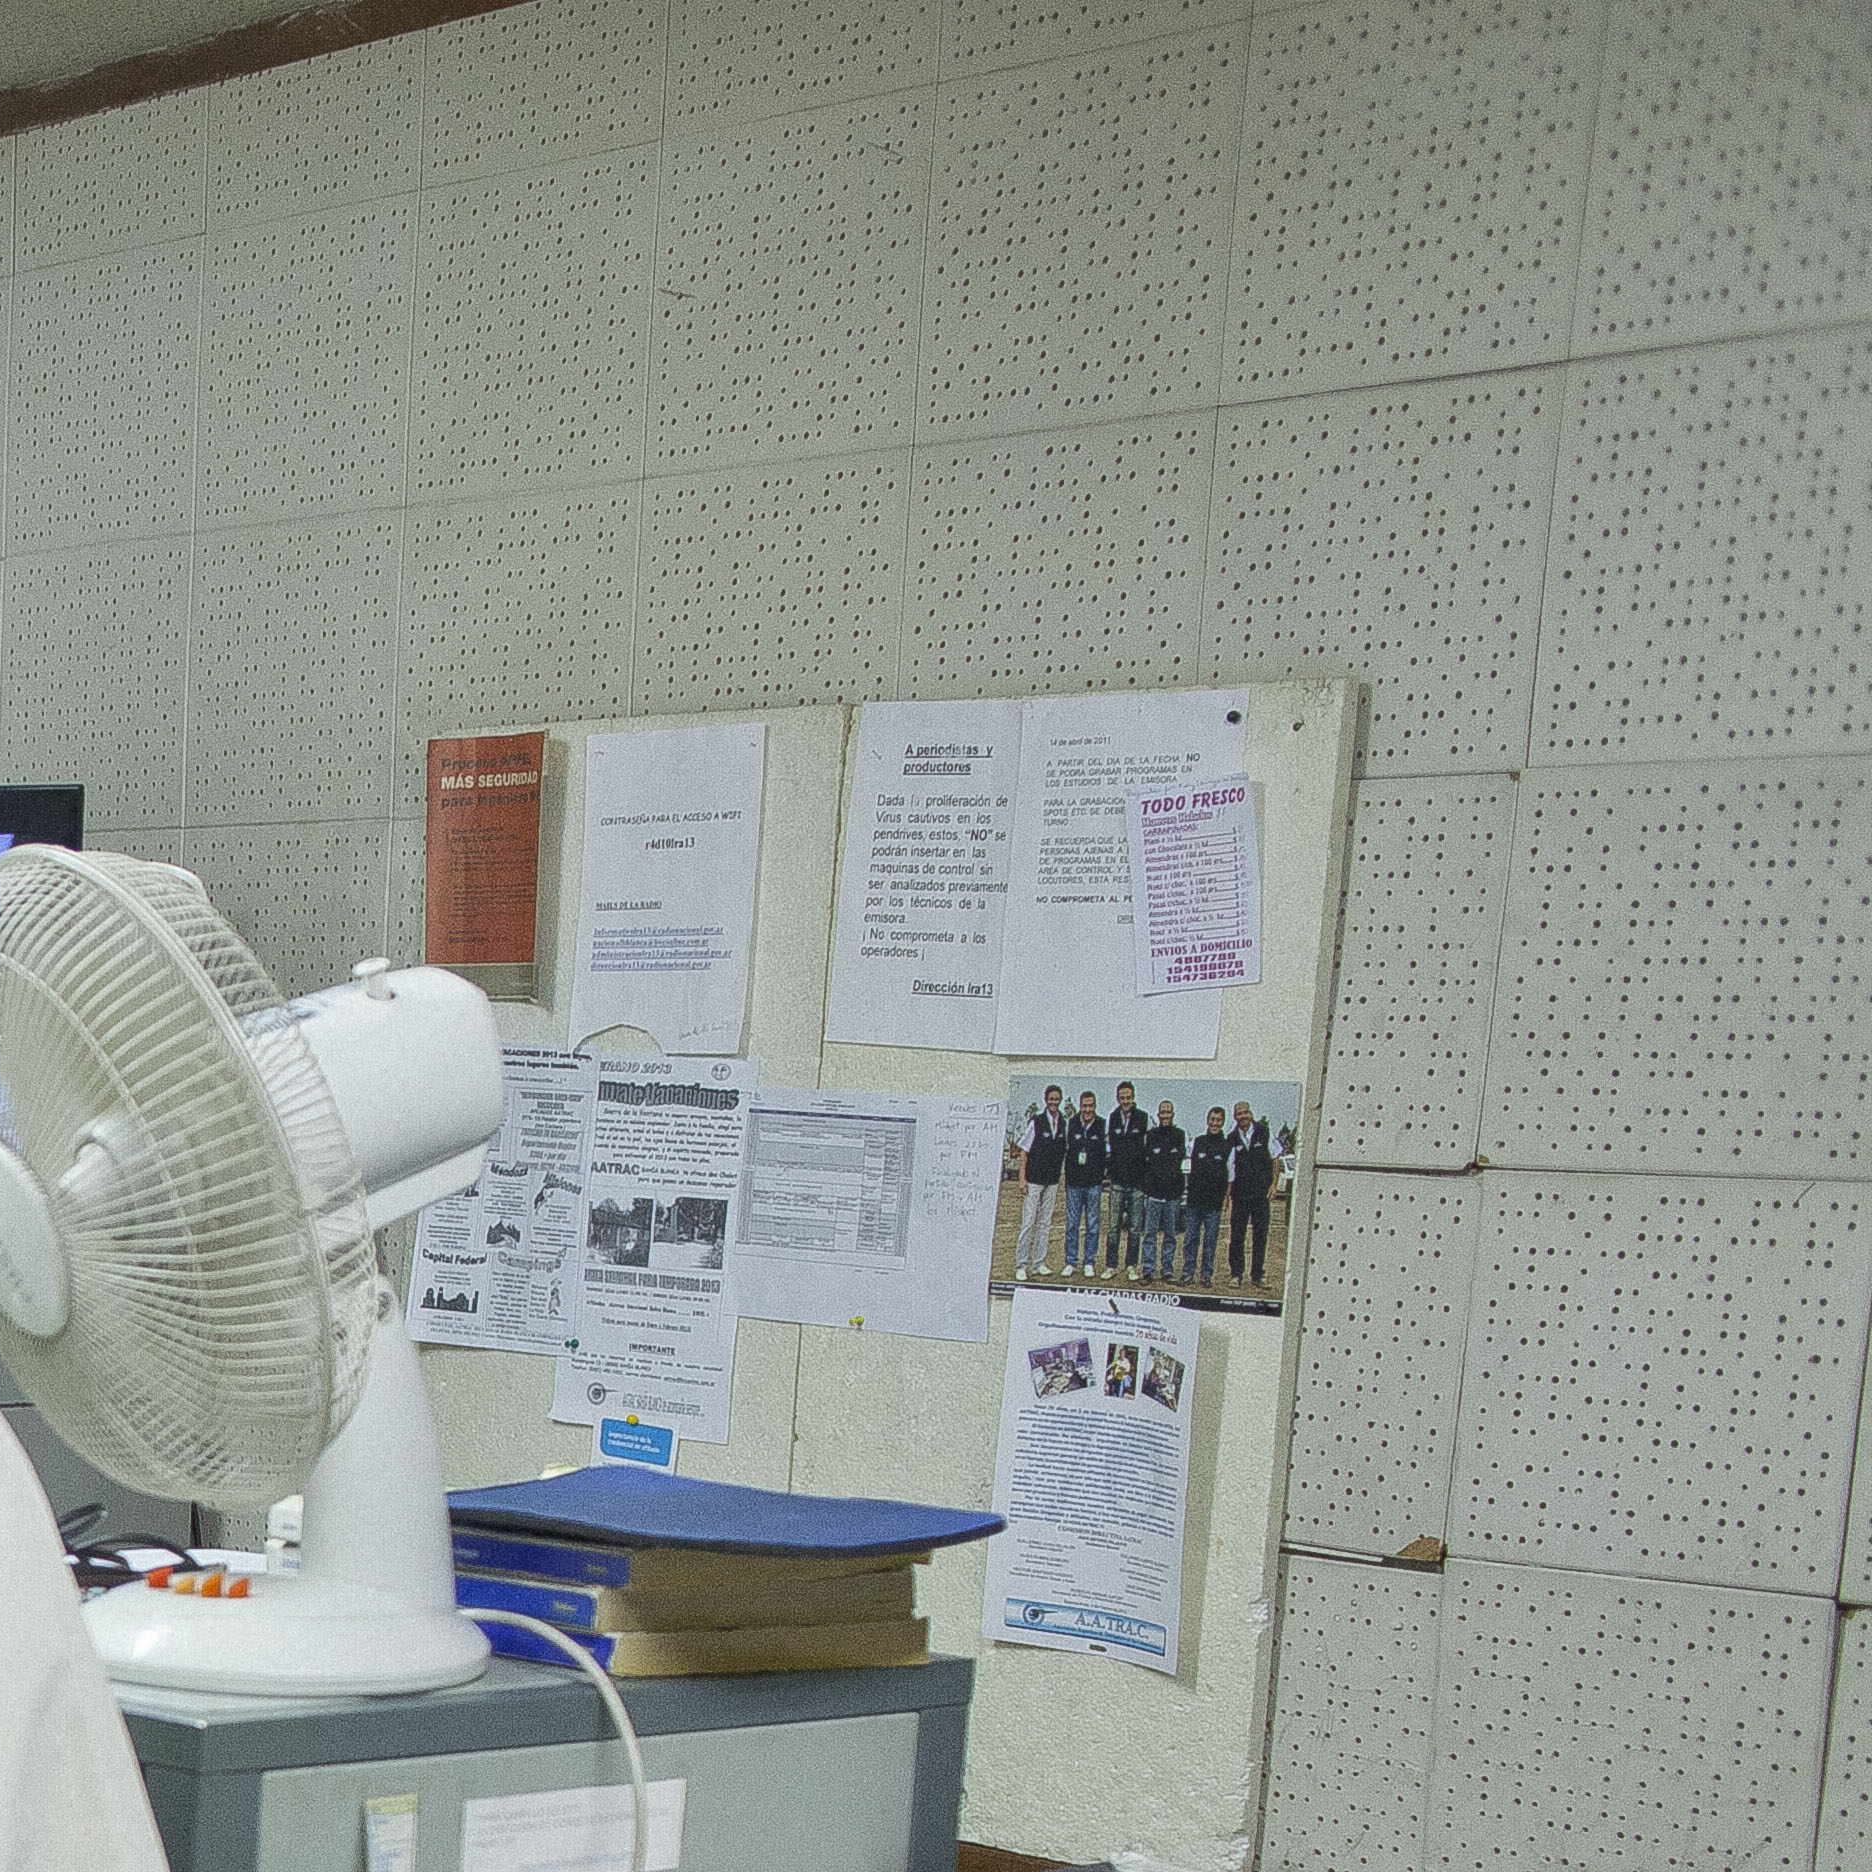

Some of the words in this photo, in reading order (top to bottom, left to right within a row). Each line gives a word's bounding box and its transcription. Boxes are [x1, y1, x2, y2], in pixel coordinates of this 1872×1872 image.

[1068, 737, 1082, 746] abril
[1084, 738, 1092, 746] de
[1094, 736, 1111, 745] 2011
[905, 744, 913, 756] A
[916, 744, 979, 757] periodistas
[986, 745, 993, 757] y
[1058, 759, 1084, 767] PARTIR
[1088, 758, 1103, 766] DEL
[1106, 757, 1120, 765] DIA
[1124, 757, 1135, 765] DE
[1140, 756, 1149, 764] LA
[1153, 755, 1180, 763] FECHA
[1186, 753, 1200, 761] NO
[903, 762, 971, 774] productores
[1089, 768, 1121, 776] GRABAR
[1126, 766, 1177, 775] PROGRAMAS
[1182, 765, 1192, 773] EN
[440, 773, 474, 789] MÁS
[478, 771, 538, 788] SEGURIDAD
[1045, 779, 1060, 788] LOS
[1064, 777, 1101, 787] ESTUDIOS
[1108, 777, 1118, 785] DE
[1124, 776, 1134, 784] LA
[1141, 775, 1177, 784] EMISORA
[877, 795, 905, 807] Dada
[925, 794, 991, 809] proliferación
[996, 795, 1008, 807] de
[1043, 799, 1064, 807] PARA
[1067, 798, 1077, 806] LA
[1141, 796, 1186, 815] TODO
[1192, 787, 1245, 808] FRESCO
[601, 813, 650, 826] CONTRASEÑA
[651, 814, 671, 824] PARA
[672, 814, 680, 822] EL
[683, 812, 712, 822] ACCESO
[714, 813, 720, 821] A
[721, 811, 742, 820] WIFI
[876, 811, 902, 823] Virus
[908, 812, 950, 824] cautivos
[957, 814, 970, 824] en
[976, 812, 991, 824] los
[1043, 808, 1067, 816] SPOTS
[873, 829, 926, 842] pendrives,
[995, 831, 1006, 841] se
[1041, 838, 1052, 846] SE
[1055, 837, 1096, 845] RECUERDA
[1097, 836, 1114, 844] QUE
[871, 845, 907, 859] podrán
[911, 846, 950, 857] insertar
[953, 848, 965, 858] en
[972, 847, 986, 858] las
[1040, 848, 1080, 856] PERSONAS
[1084, 847, 1114, 855] AJENAS
[1039, 857, 1050, 865] DE
[1053, 857, 1101, 865] PROGRAMAS
[1105, 856, 1116, 864] EN
[870, 863, 919, 876] maquinas
[923, 863, 935, 874] de
[939, 863, 975, 874] control
[980, 863, 993, 875] sin
[1062, 866, 1072, 874] DE
[1076, 865, 1113, 874] CONTROL
[1117, 865, 1124, 873] Y
[1089, 875, 1108, 884] ESTA
[868, 879, 885, 890] ser
[890, 880, 945, 891] analizados
[949, 881, 1008, 895] previamente
[620, 902, 628, 910] DE
[630, 901, 638, 909] LA
[640, 901, 662, 909] RADIO
[865, 896, 883, 909] por
[889, 896, 903, 907] los
[910, 897, 952, 909] técnicos
[959, 898, 972, 909] de
[978, 899, 986, 909] la
[1051, 895, 1105, 903] COMPROMETA
[1109, 895, 1120, 903] AL
[870, 928, 885, 940] No
[890, 930, 954, 944] comprometa
[961, 934, 967, 943] a
[973, 933, 986, 944] los
[861, 945, 918, 958] operadores
[1151, 944, 1188, 957] ENVIOS
[1191, 943, 1198, 953] A
[1200, 939, 1253, 952] DOMICILIO
[913, 980, 964, 994] Dirección
[591, 1162, 640, 1175] AATRAC
[422, 1247, 453, 1264] Capital
[455, 1253, 487, 1265] Federal
[1144, 1292, 1181, 1306] RADIO
[628, 1343, 676, 1356] IMPORTANTE
